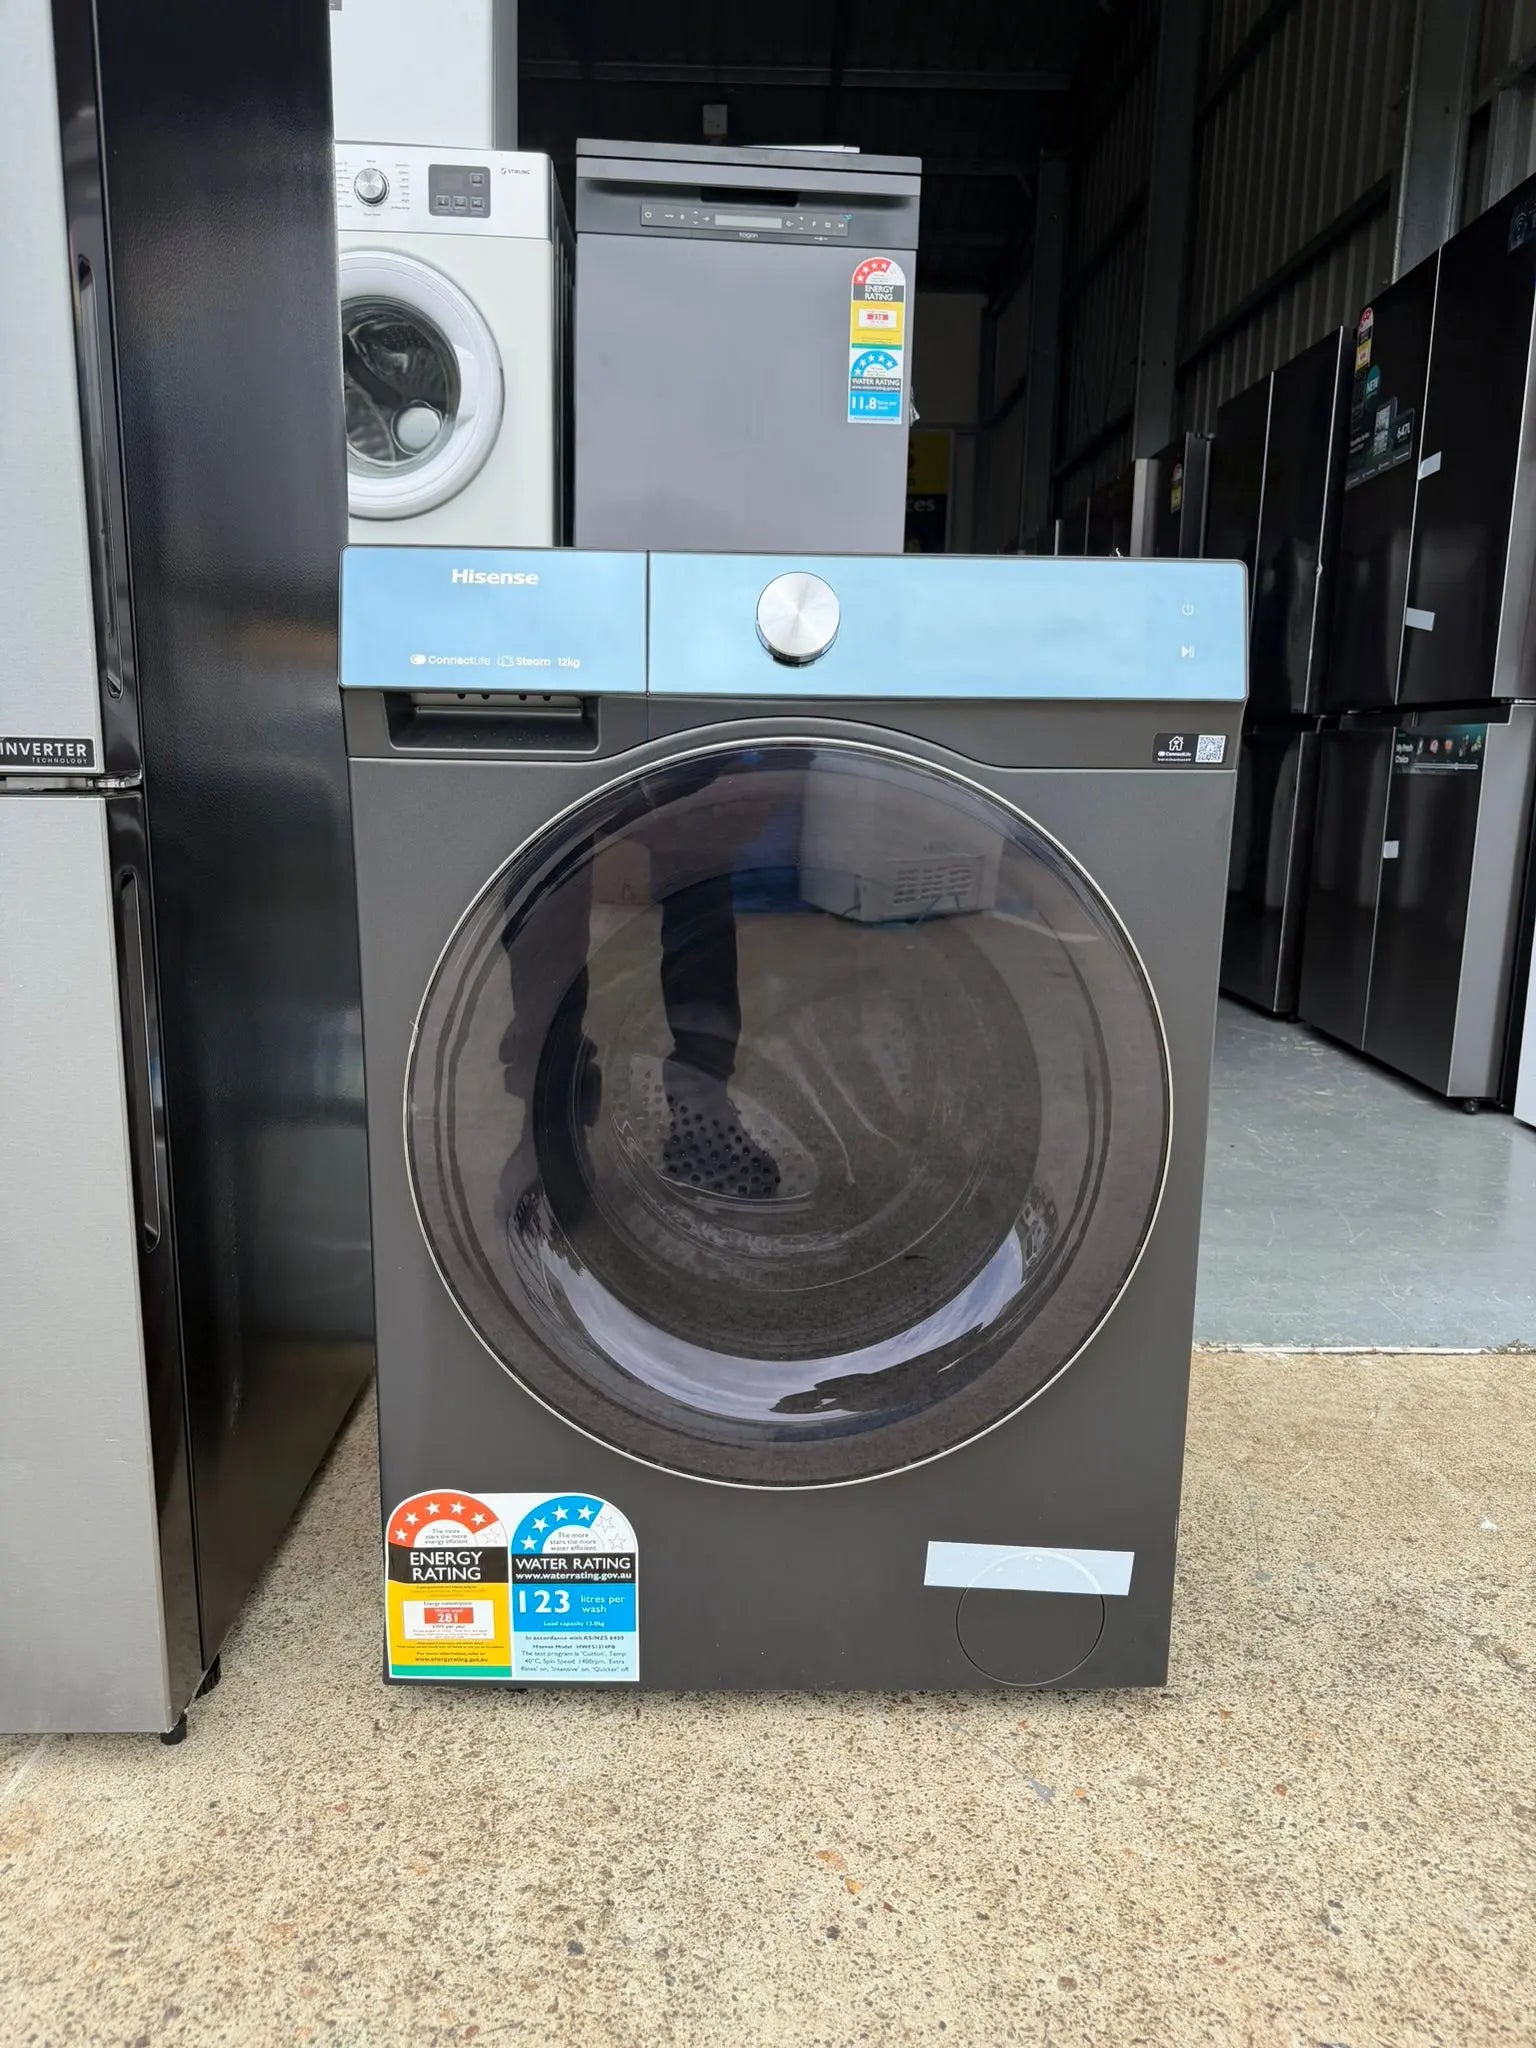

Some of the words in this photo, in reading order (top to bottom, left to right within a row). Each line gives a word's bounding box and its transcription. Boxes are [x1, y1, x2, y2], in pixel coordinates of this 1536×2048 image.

[864, 285, 895, 294] ENERGY
[864, 293, 894, 301] RATING
[851, 378, 874, 386] WATER
[875, 379, 900, 387] RATING
[851, 396, 877, 410] 11.8
[451, 568, 540, 585] Hisense
[428, 655, 491, 666] ConnectLife
[516, 656, 550, 667] Steam
[558, 657, 581, 668] 12kg
[0, 741, 87, 757] INVERTER
[32, 757, 88, 765] TECHNOLOGY
[410, 1551, 483, 1566] ENERGY
[515, 1557, 568, 1570] WATER
[573, 1557, 631, 1570] RATING
[412, 1567, 482, 1582] RATING
[515, 1571, 632, 1581] www.waterrating.gov.au
[518, 1589, 571, 1614] 123
[580, 1594, 605, 1603] litres
[608, 1595, 625, 1605] per
[581, 1605, 607, 1613] wash
[437, 1613, 459, 1623] 281
